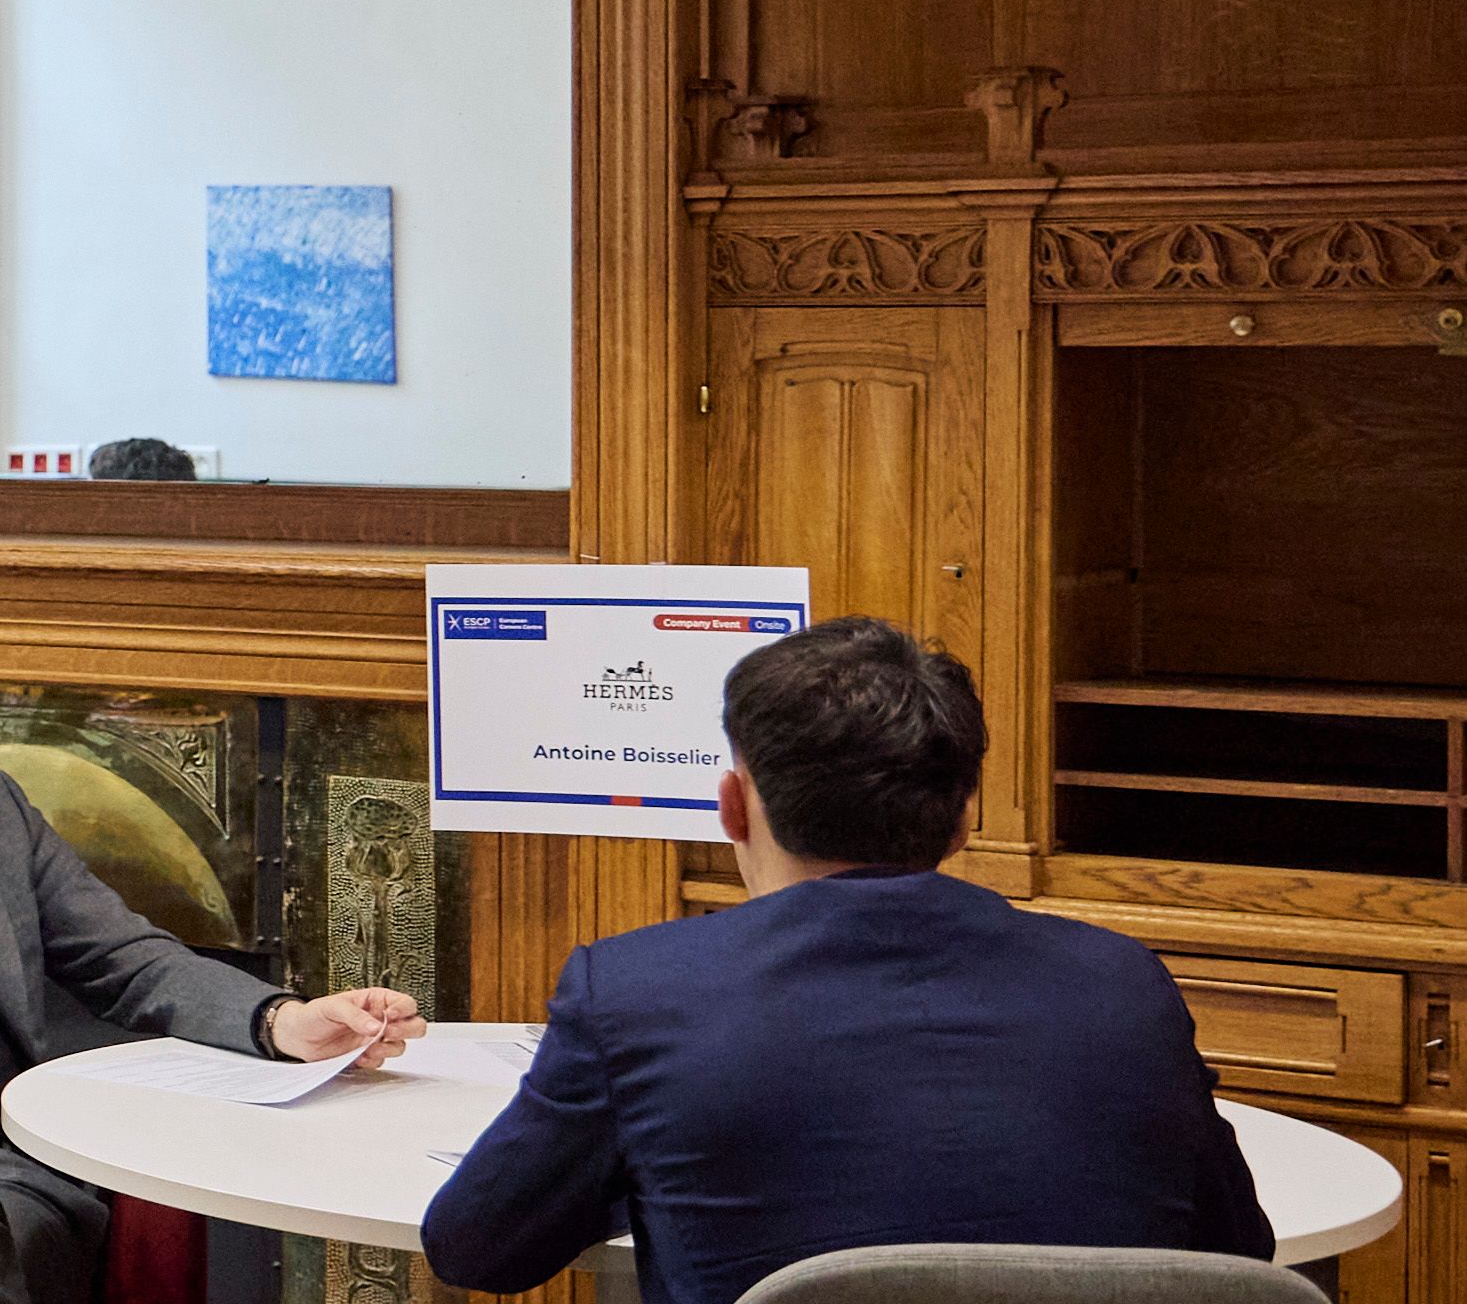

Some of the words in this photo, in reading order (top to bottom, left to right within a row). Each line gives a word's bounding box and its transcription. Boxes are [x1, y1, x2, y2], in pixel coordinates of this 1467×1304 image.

[463, 617, 491, 626] ESCP
[662, 617, 711, 630] Company
[712, 619, 742, 629] Event
[754, 619, 786, 631] Onsite
[583, 683, 674, 700] HERMÈS
[609, 702, 648, 712] PARIS
[533, 744, 617, 762] Antoine
[622, 747, 721, 766] Boisselier
